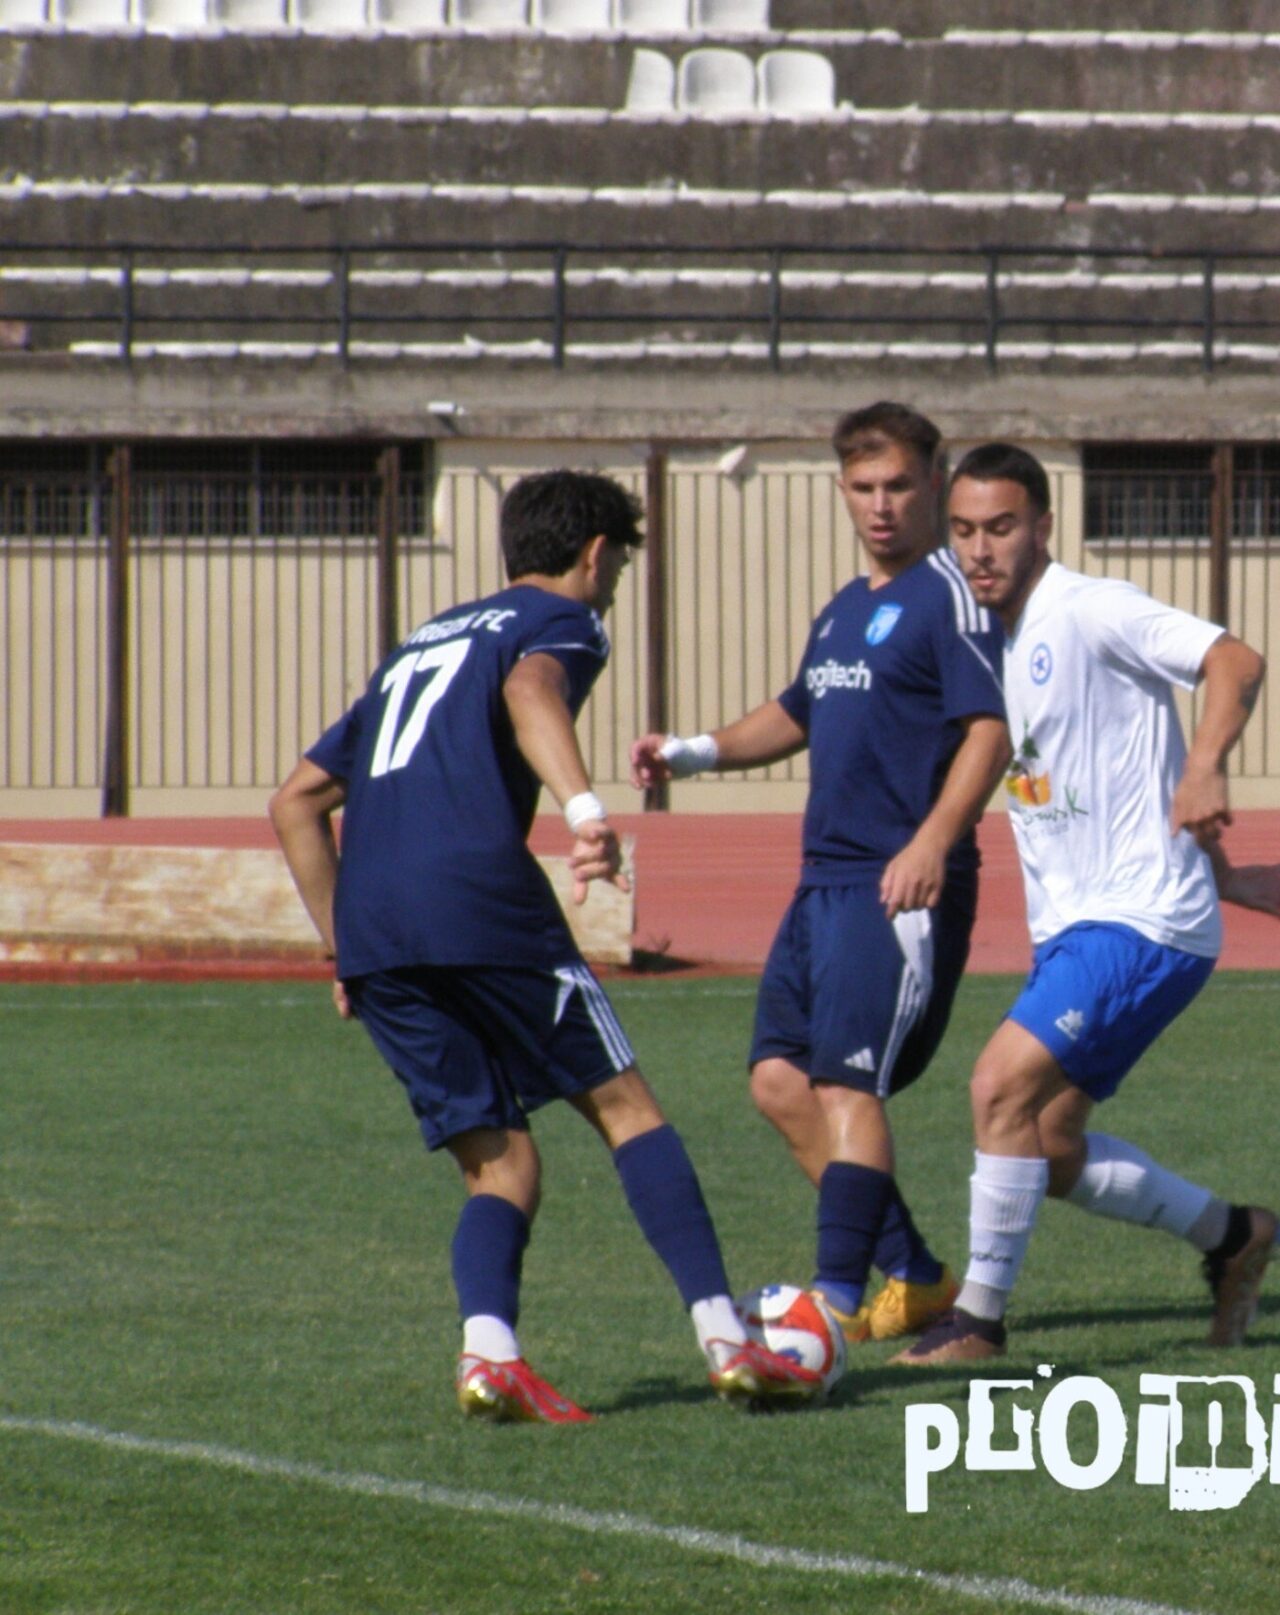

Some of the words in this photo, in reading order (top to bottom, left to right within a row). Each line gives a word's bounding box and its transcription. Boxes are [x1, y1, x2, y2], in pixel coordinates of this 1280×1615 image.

[471, 608, 518, 632] FC
[805, 658, 872, 699] ogitech
[371, 638, 472, 778] 17
